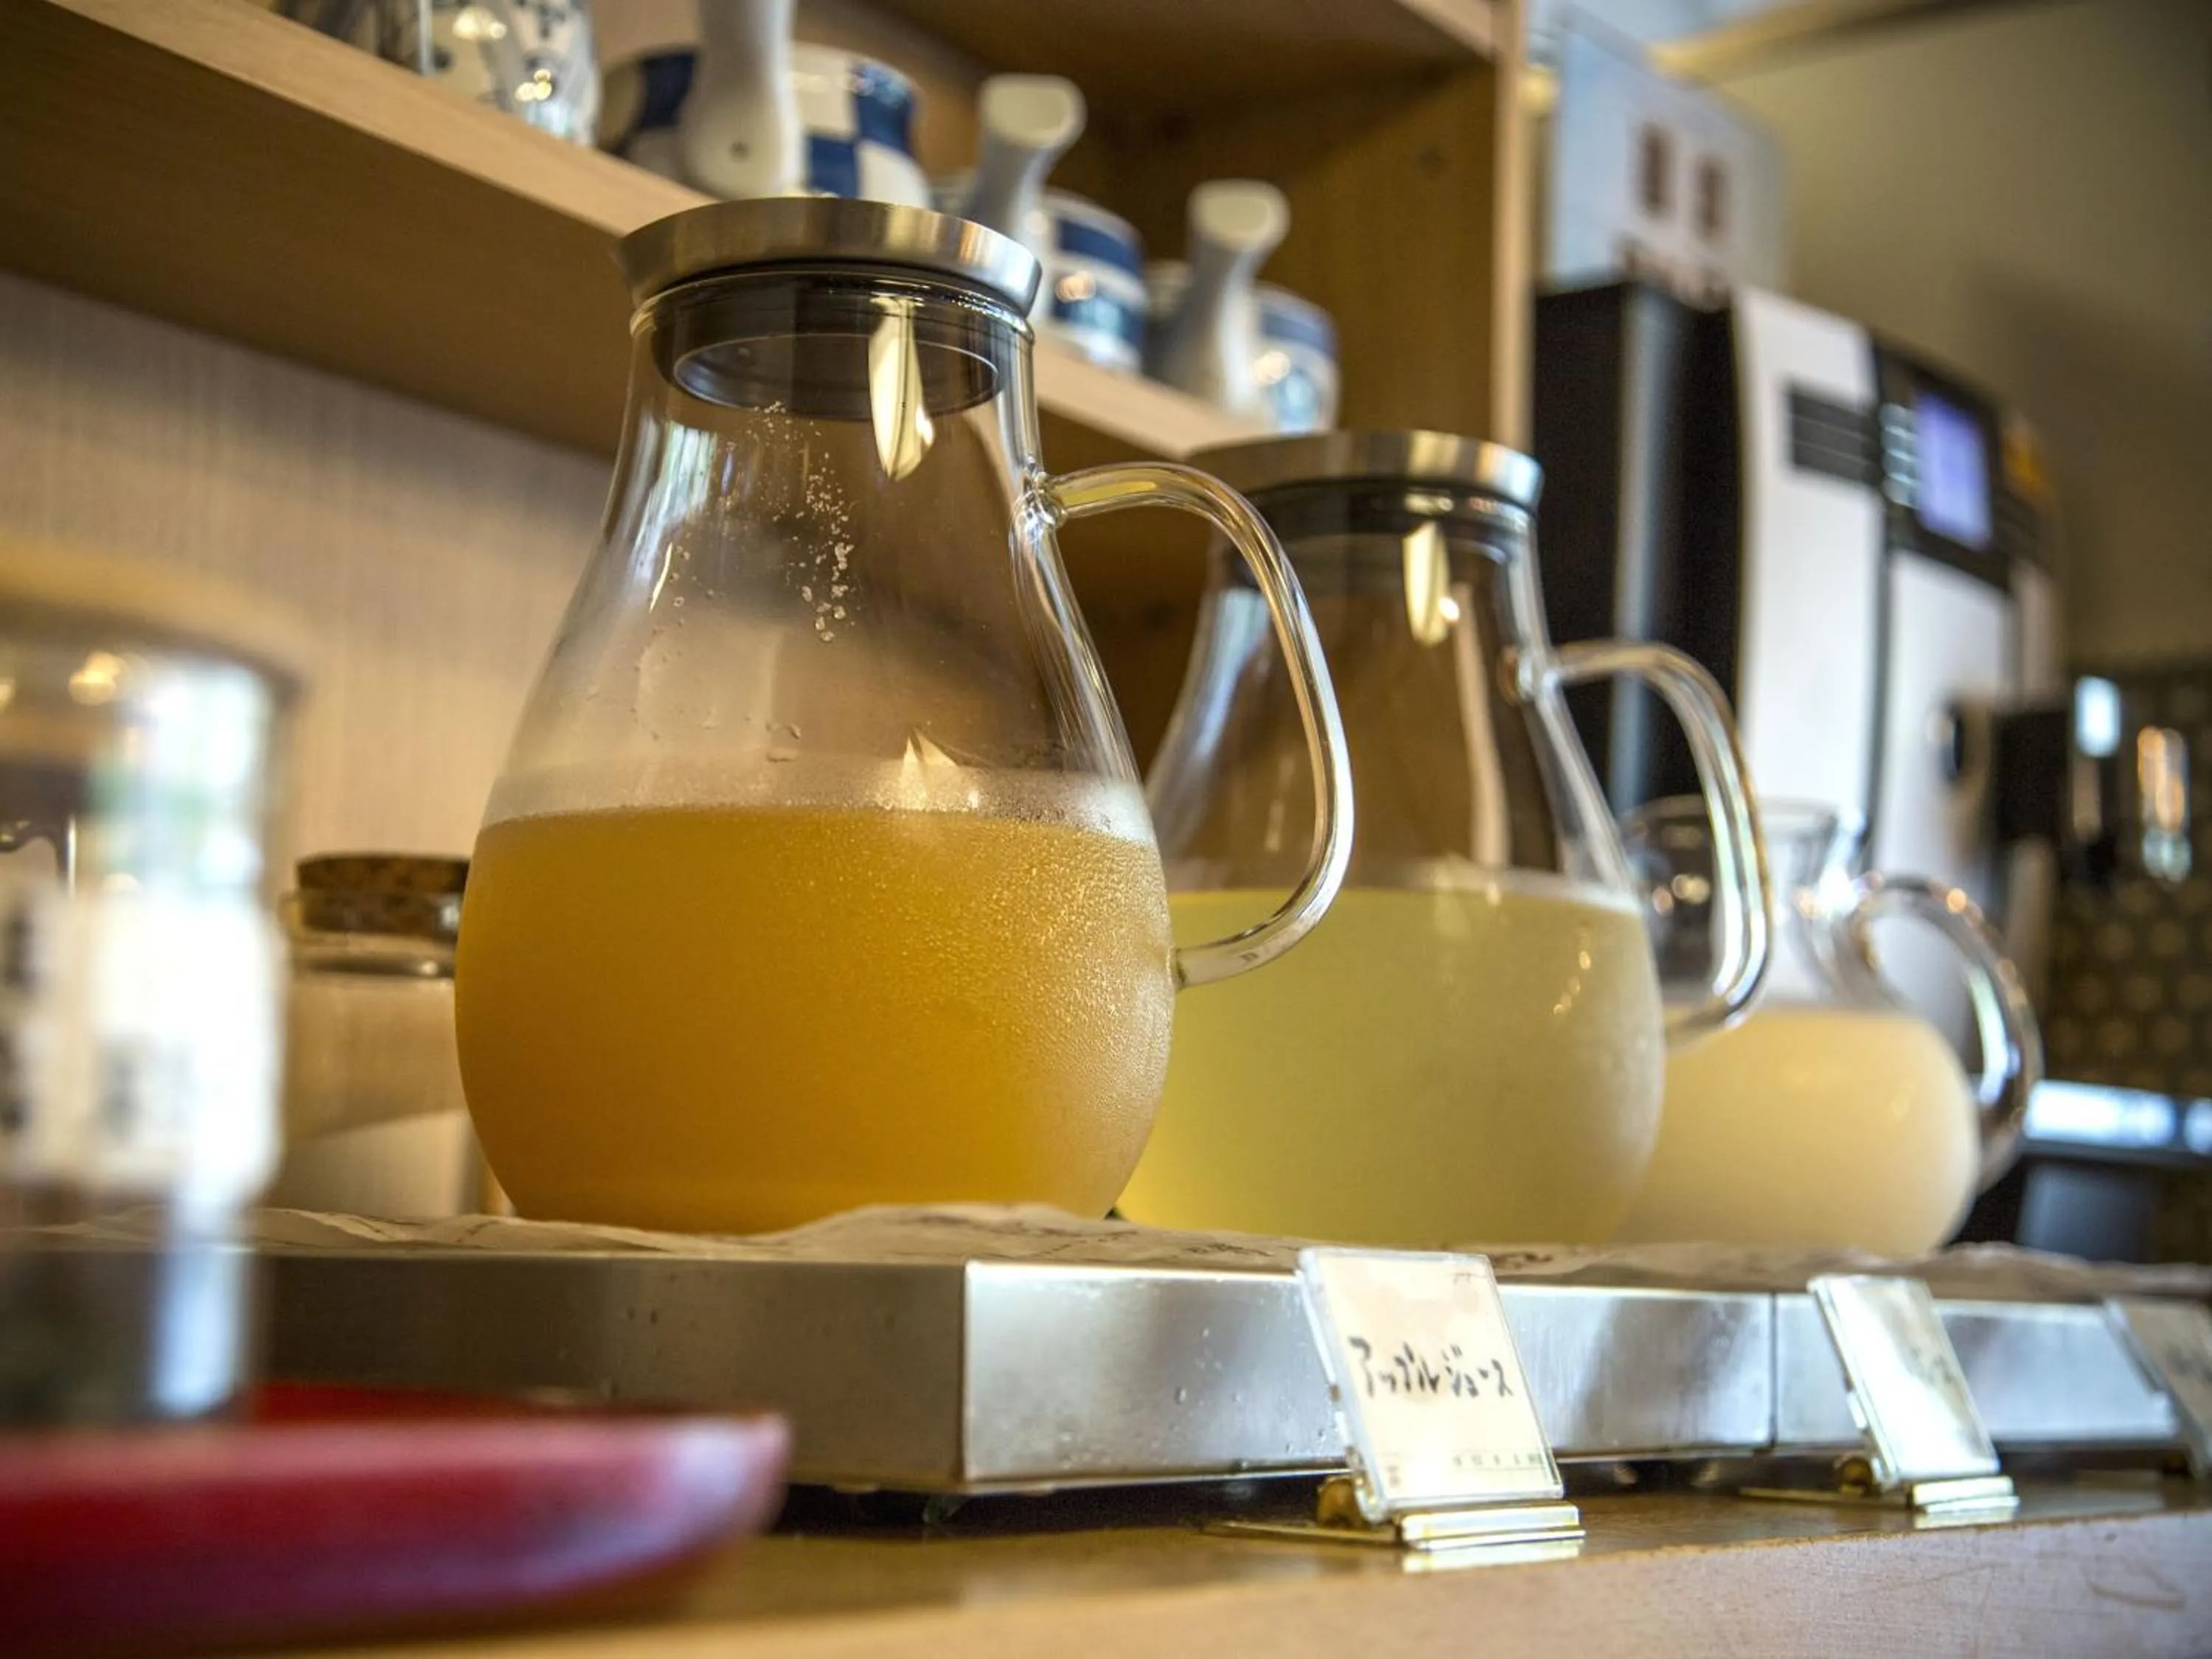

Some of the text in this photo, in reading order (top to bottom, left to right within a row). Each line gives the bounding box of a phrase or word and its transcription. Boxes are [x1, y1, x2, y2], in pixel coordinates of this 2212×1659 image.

[1349, 1336, 1514, 1398] アップルジュース
